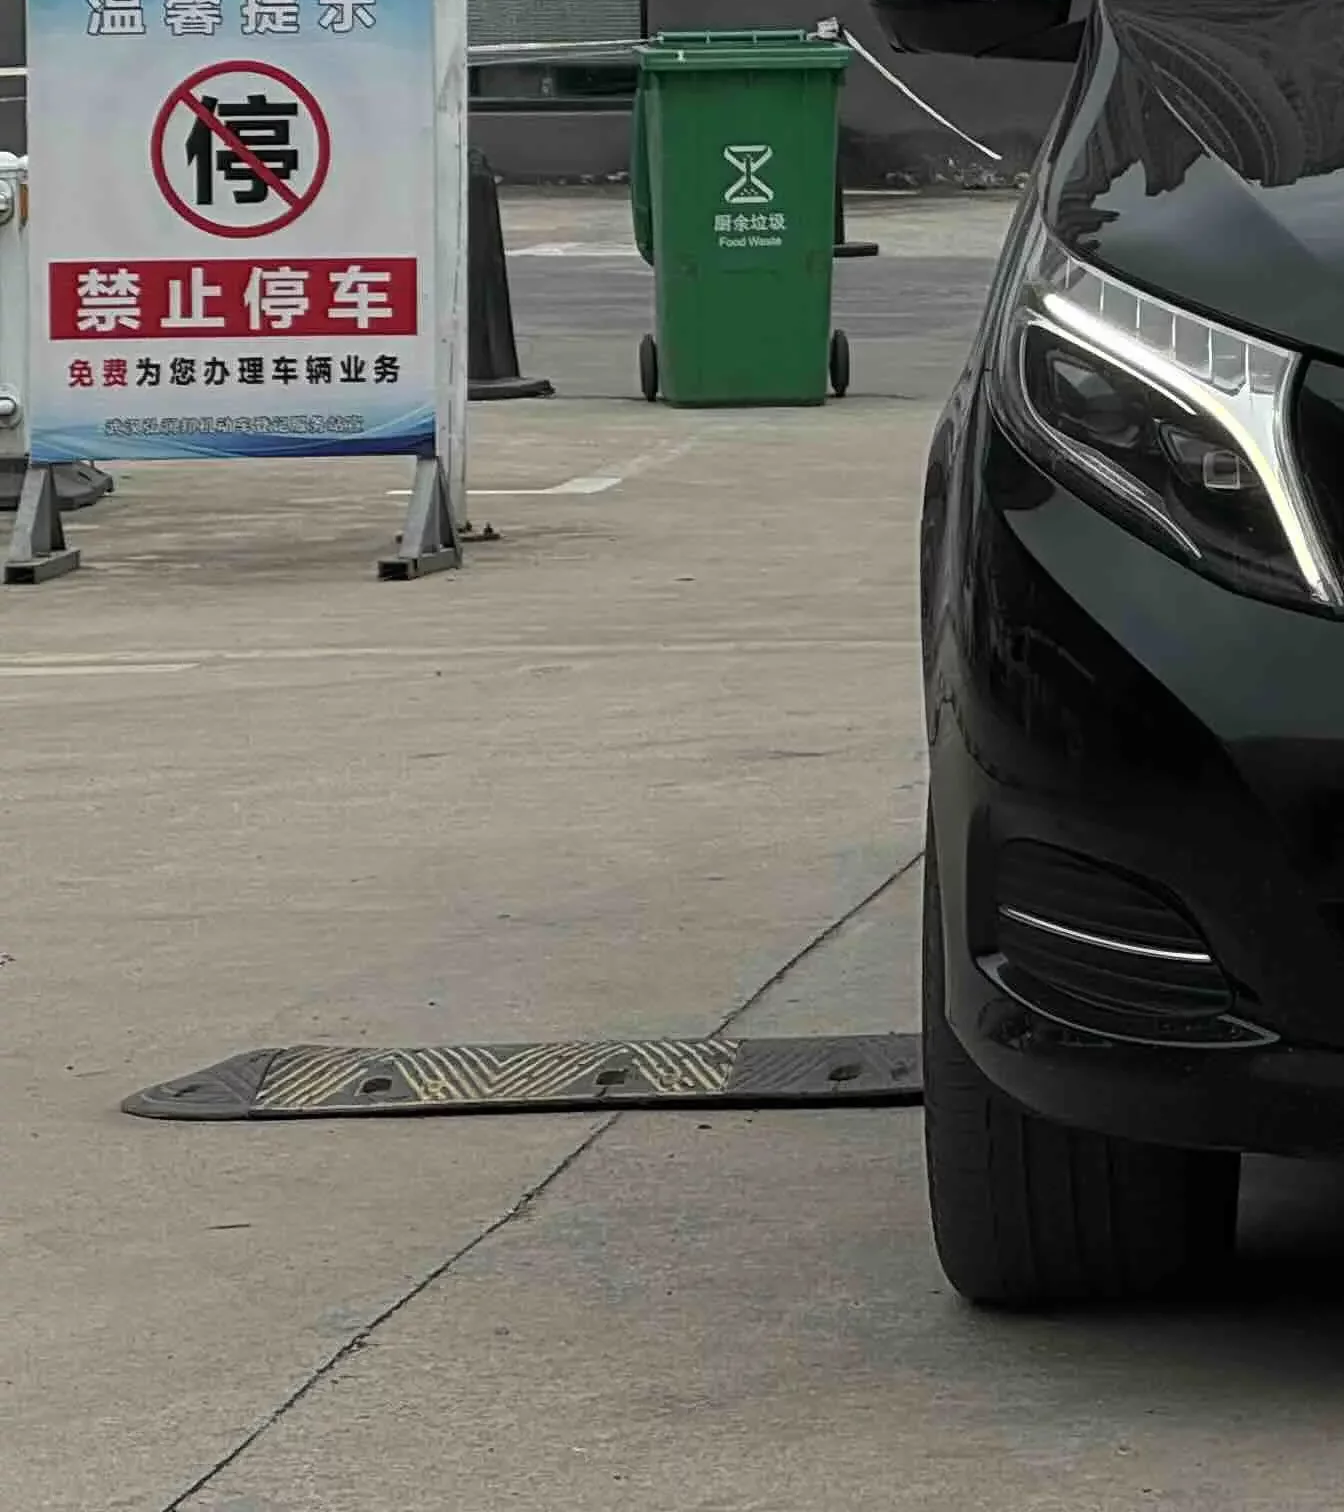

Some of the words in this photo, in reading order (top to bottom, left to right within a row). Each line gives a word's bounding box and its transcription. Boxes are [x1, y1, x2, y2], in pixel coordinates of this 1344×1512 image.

[715, 213, 786, 232] 厨余垃圾
[719, 236, 746, 248] Food
[77, 264, 395, 332] 禁止停车
[68, 354, 401, 388] 免费为您办理车辆业务
